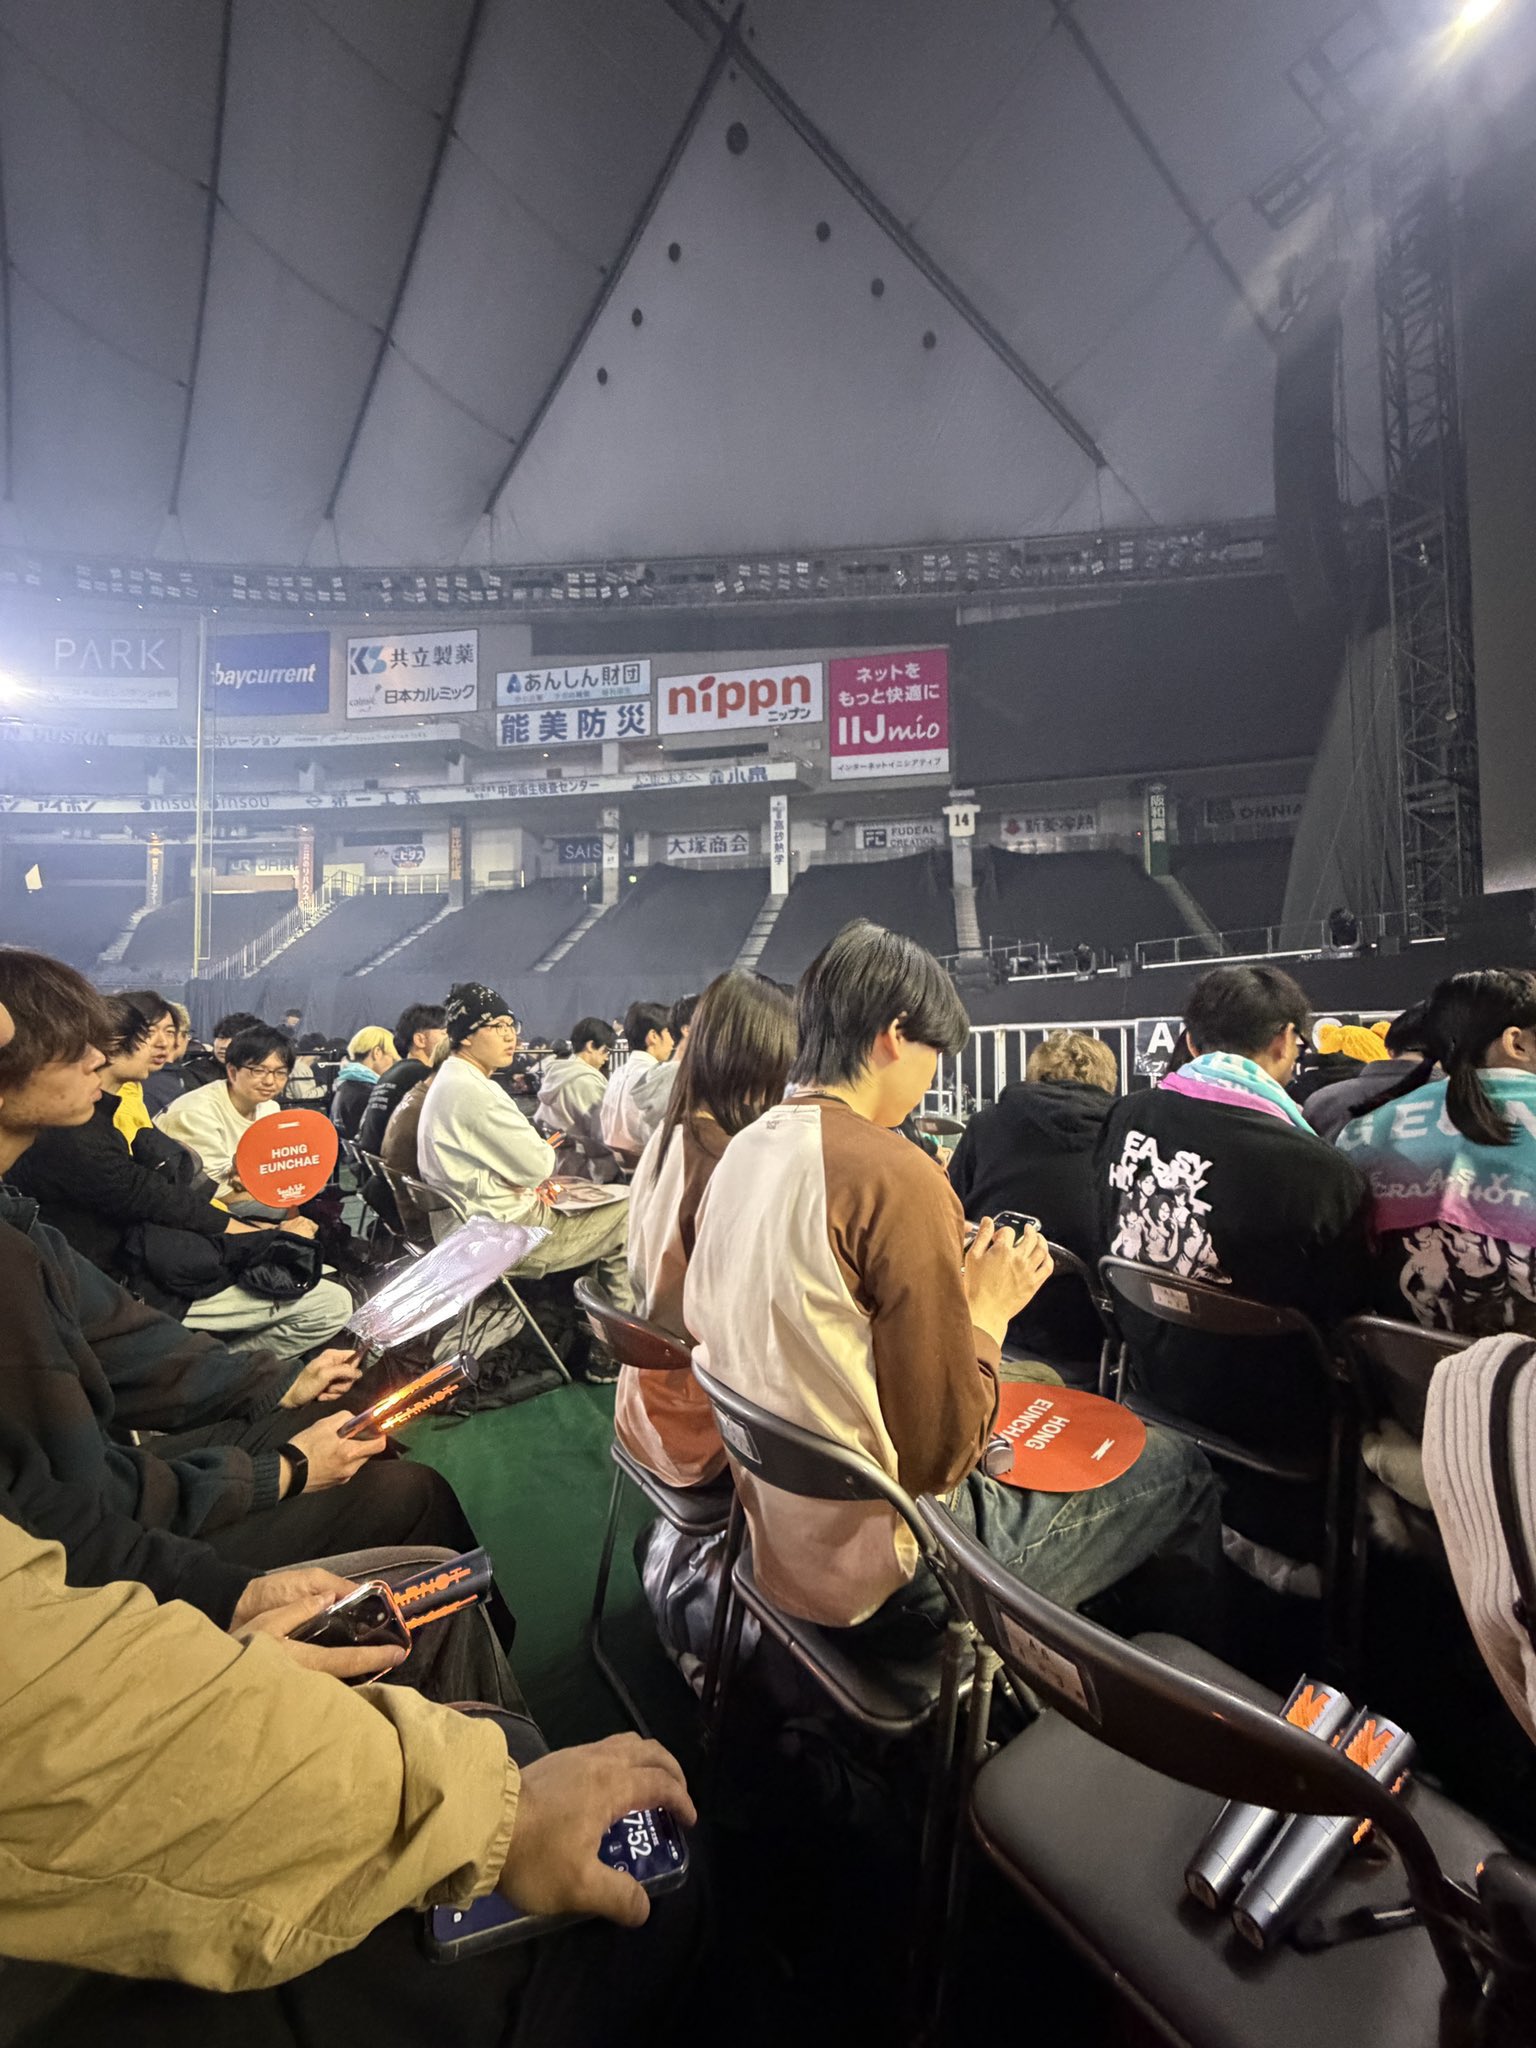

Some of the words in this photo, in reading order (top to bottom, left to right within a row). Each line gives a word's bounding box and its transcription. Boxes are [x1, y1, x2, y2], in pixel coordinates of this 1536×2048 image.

[54, 638, 167, 671] PARK
[390, 644, 475, 669] 共立製薬
[211, 662, 317, 689] baycurrent
[525, 663, 641, 692] あんしん財団
[857, 662, 921, 682] ネットを
[384, 685, 475, 705] 日本カルミック
[668, 674, 812, 719] nippn
[839, 684, 941, 708] もっと快適に
[501, 704, 646, 744] 能美防災
[768, 707, 811, 722] ニップン
[838, 714, 940, 746] IIJmio
[837, 757, 942, 772] インターネットイニシアティブ
[497, 779, 600, 797] 中部衛生検査センター
[954, 813, 969, 828] 14
[565, 842, 633, 860] SAISN
[668, 834, 748, 855] 大塚商会
[773, 820, 785, 865] 高砂熱学
[271, 1144, 308, 1159] HONG
[259, 1154, 321, 1175] EUNCHAE
[1002, 1398, 1054, 1444] EUNCHA
[1024, 1415, 1070, 1451] HONG
[622, 1810, 653, 1861] 7:52
